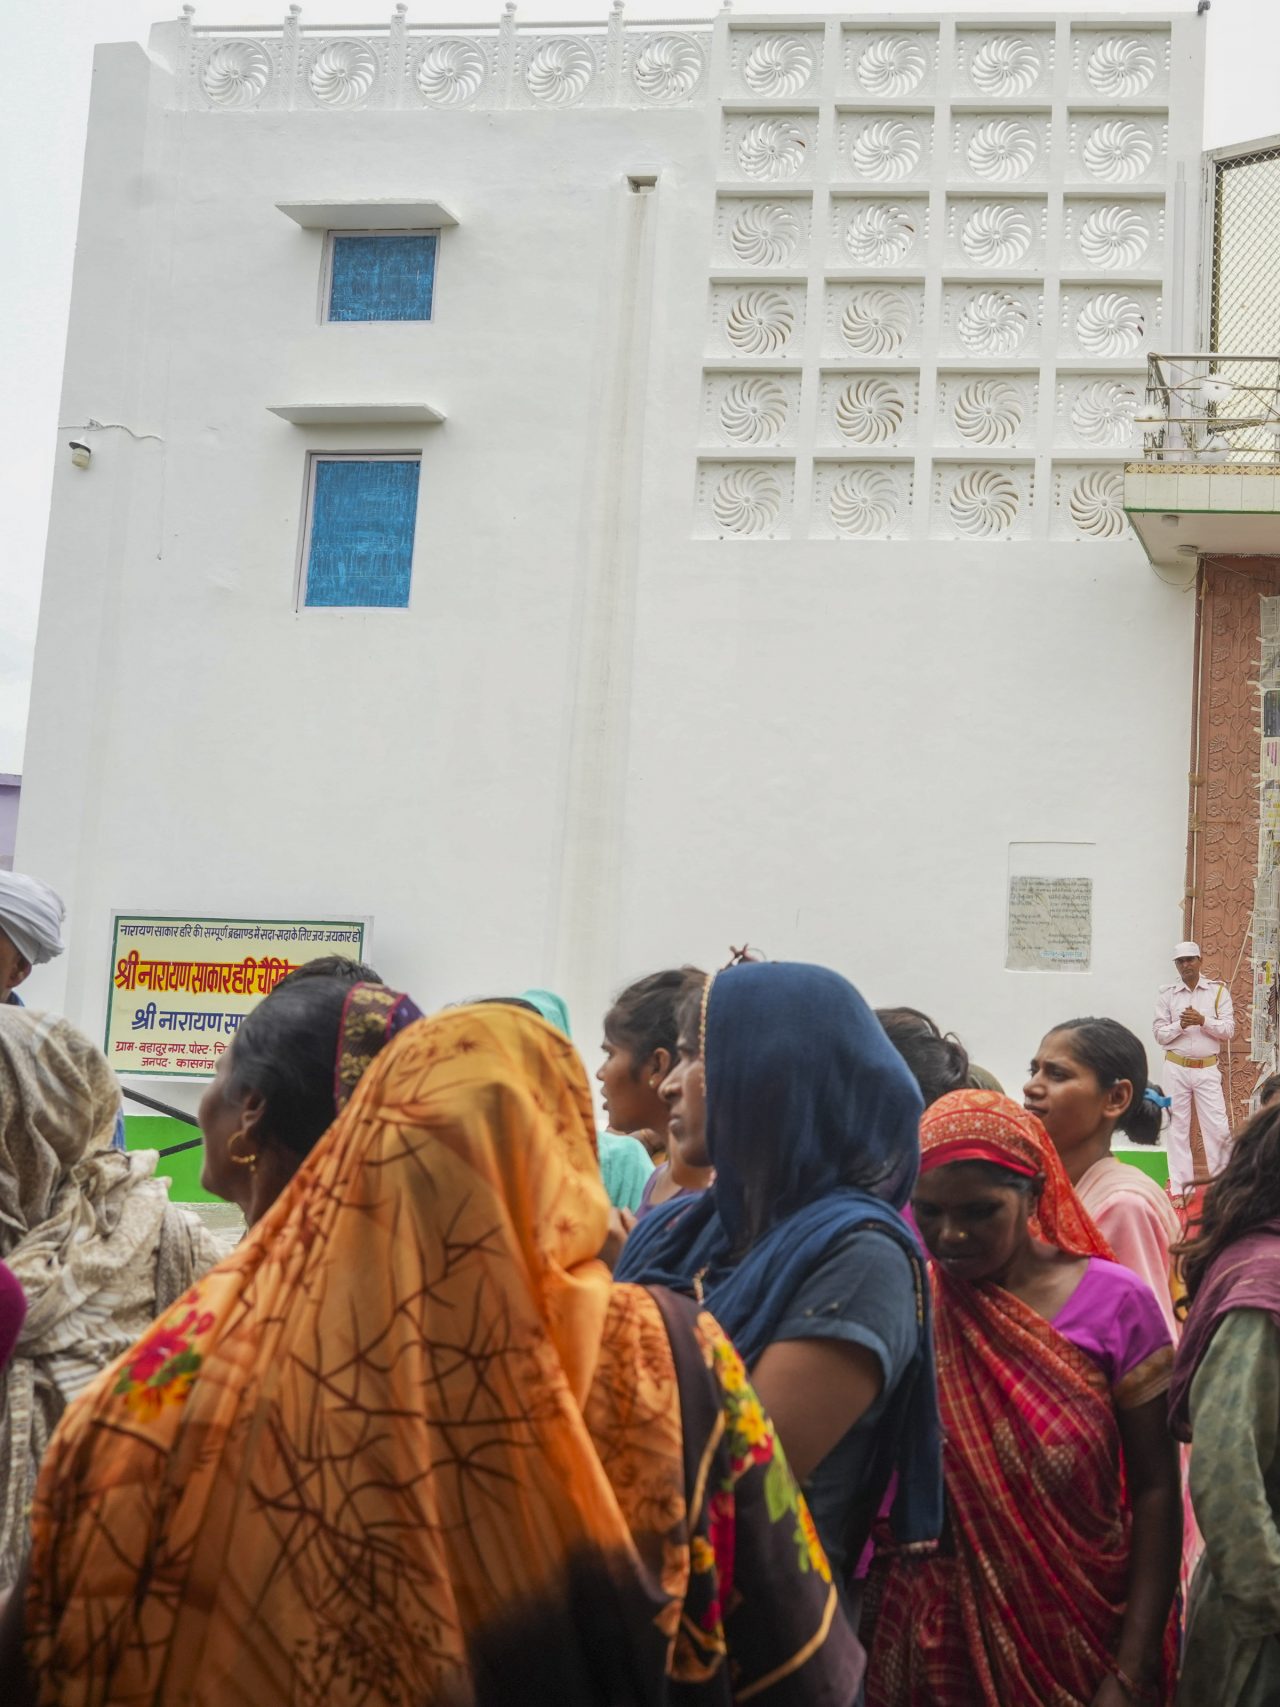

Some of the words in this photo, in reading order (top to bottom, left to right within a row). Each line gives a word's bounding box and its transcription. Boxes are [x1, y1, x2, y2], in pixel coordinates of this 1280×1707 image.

[120, 924, 154, 937] नारायण
[154, 926, 178, 937] साकार
[179, 923, 193, 938] हरि
[193, 923, 203, 938] की
[291, 926, 298, 940] के
[298, 926, 313, 941] लिए
[352, 928, 361, 943] हो
[114, 949, 140, 990] श्री
[138, 960, 193, 992] नारायण
[192, 962, 233, 994] साकार
[232, 956, 258, 995] हरि
[131, 1002, 157, 1030] श्री
[159, 1010, 224, 1032] नारायण
